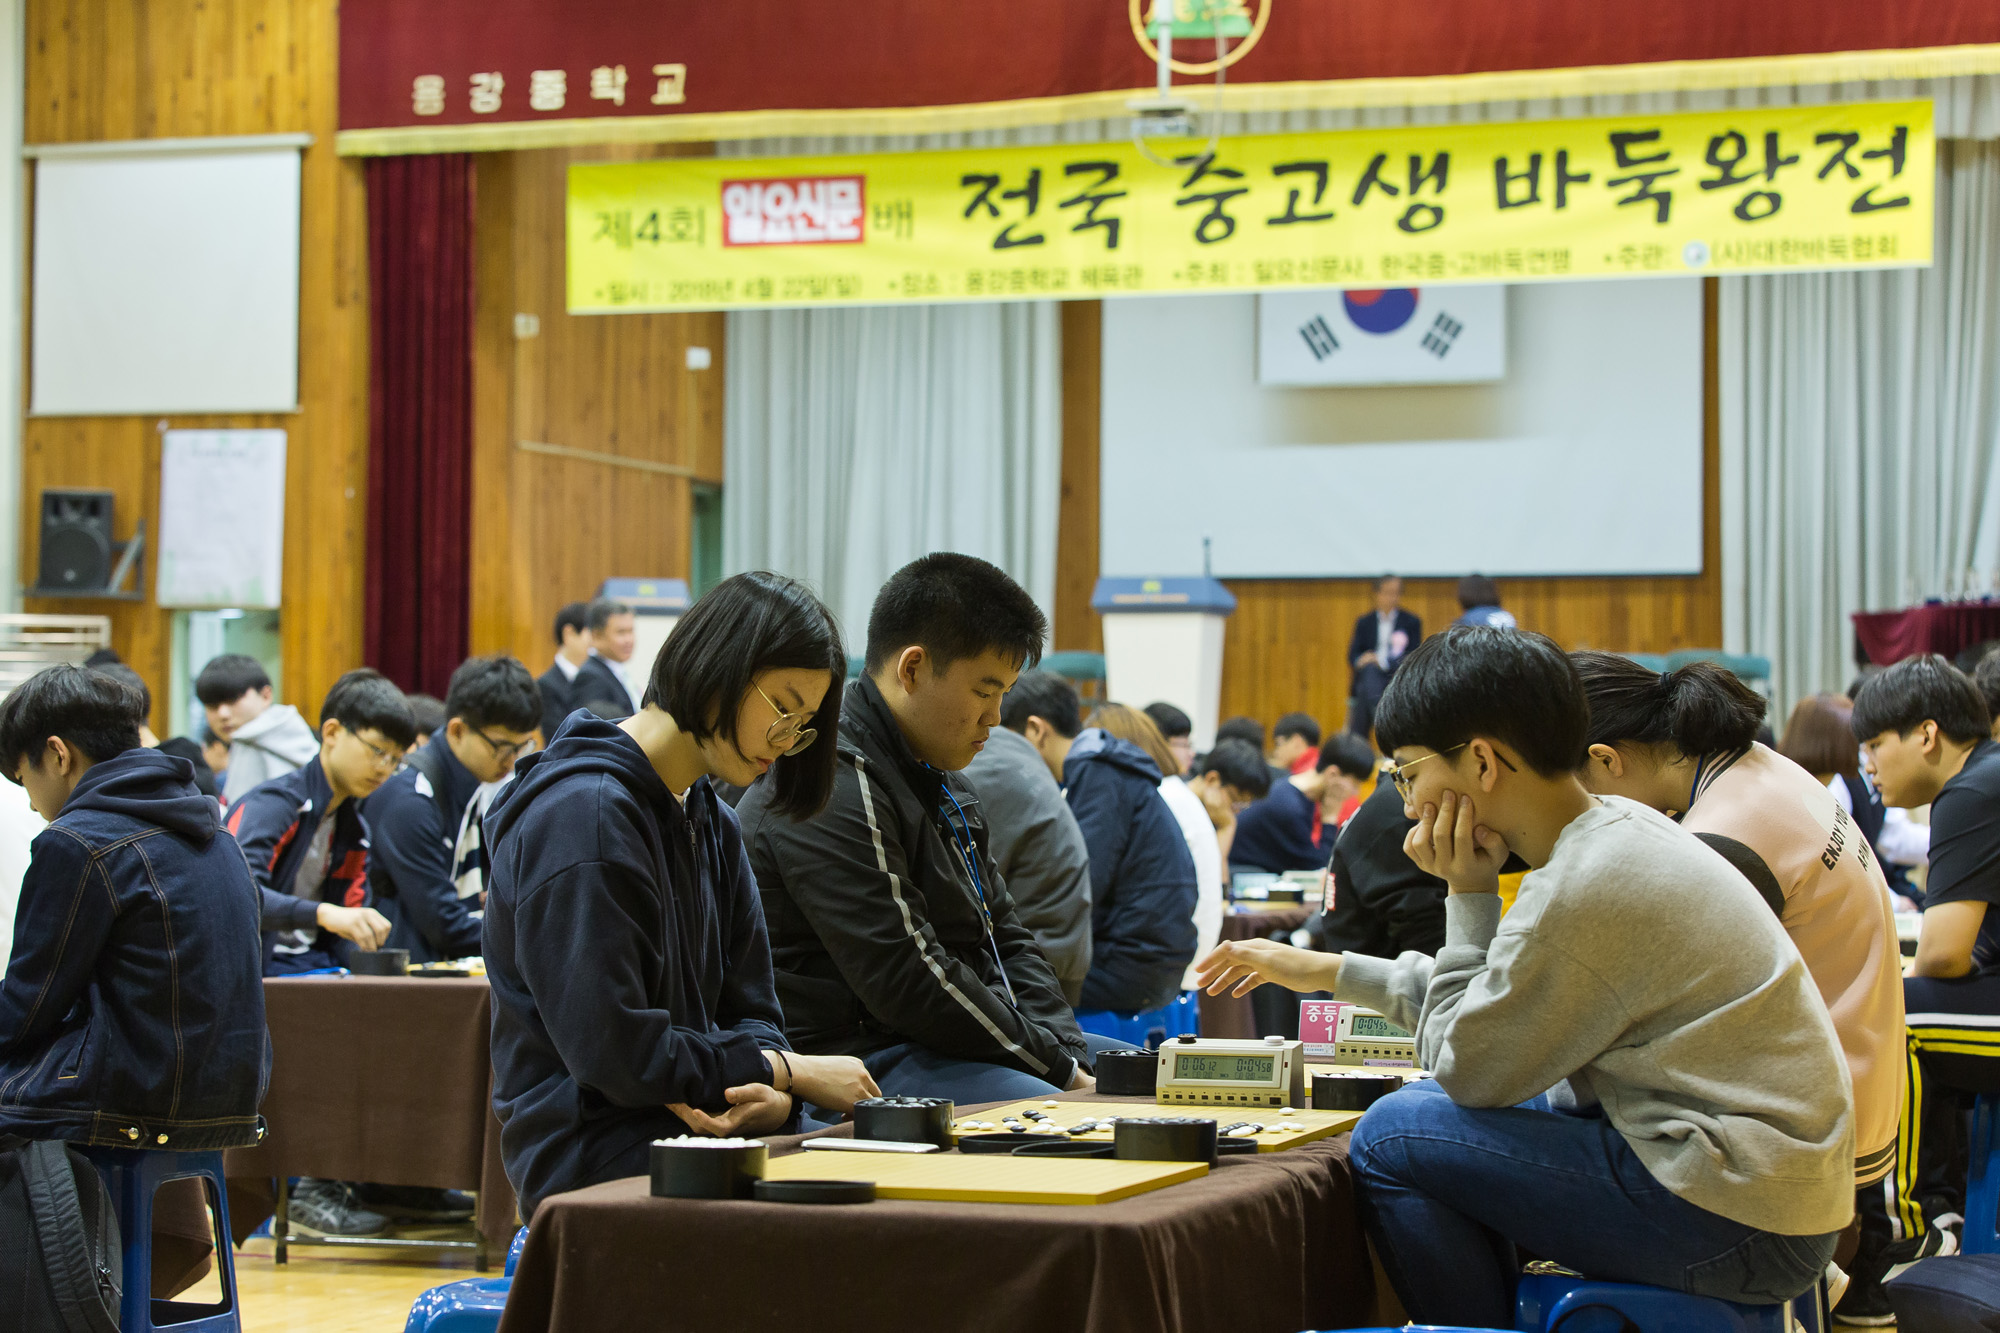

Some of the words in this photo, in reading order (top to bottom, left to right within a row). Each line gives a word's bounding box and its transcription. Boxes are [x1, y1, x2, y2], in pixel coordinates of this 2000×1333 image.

[593, 206, 705, 249] 제4회
[724, 180, 862, 243] 일요신문
[873, 197, 914, 240] 배
[961, 161, 1127, 249] 전국
[1174, 152, 1451, 244] 중고생
[1495, 126, 1911, 223] 바둑왕전
[1821, 824, 1846, 871] ENJOY
[1306, 1005, 1338, 1023] 중등
[1324, 1025, 1333, 1041] 1
